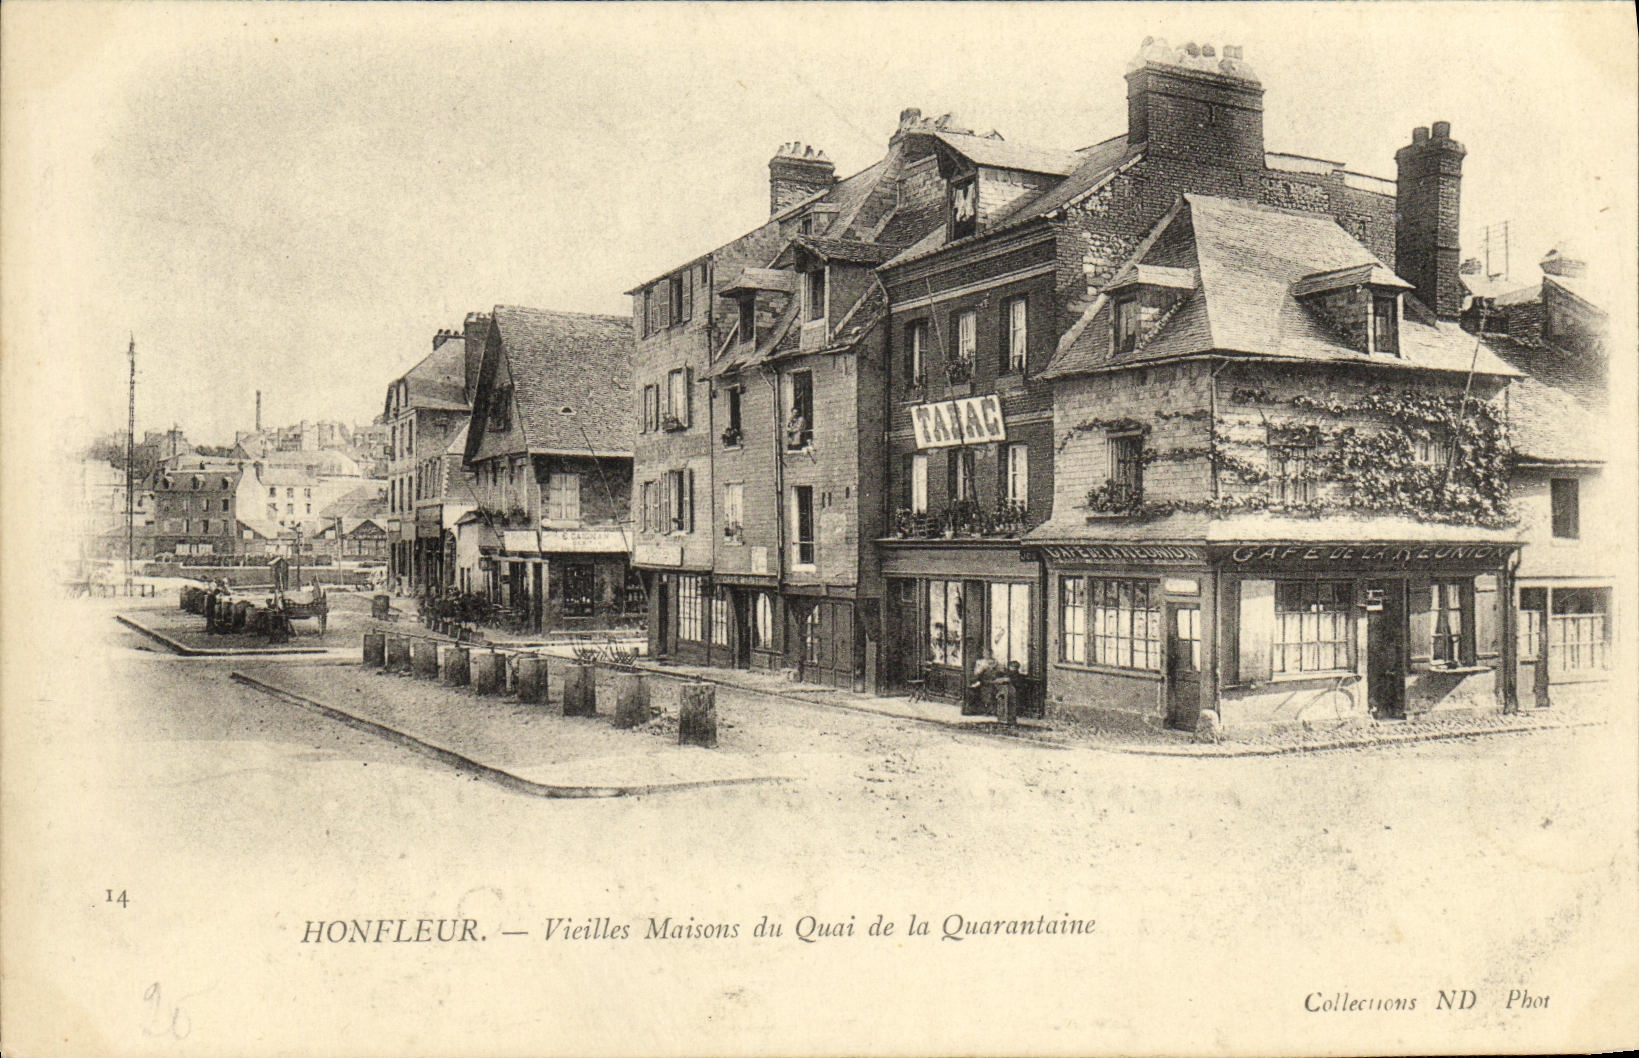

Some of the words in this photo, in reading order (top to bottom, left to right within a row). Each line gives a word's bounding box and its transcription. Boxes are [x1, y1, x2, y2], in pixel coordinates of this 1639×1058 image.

[915, 398, 1001, 443] TABAC
[1329, 546, 1355, 560] DE
[1361, 546, 1391, 560] LA
